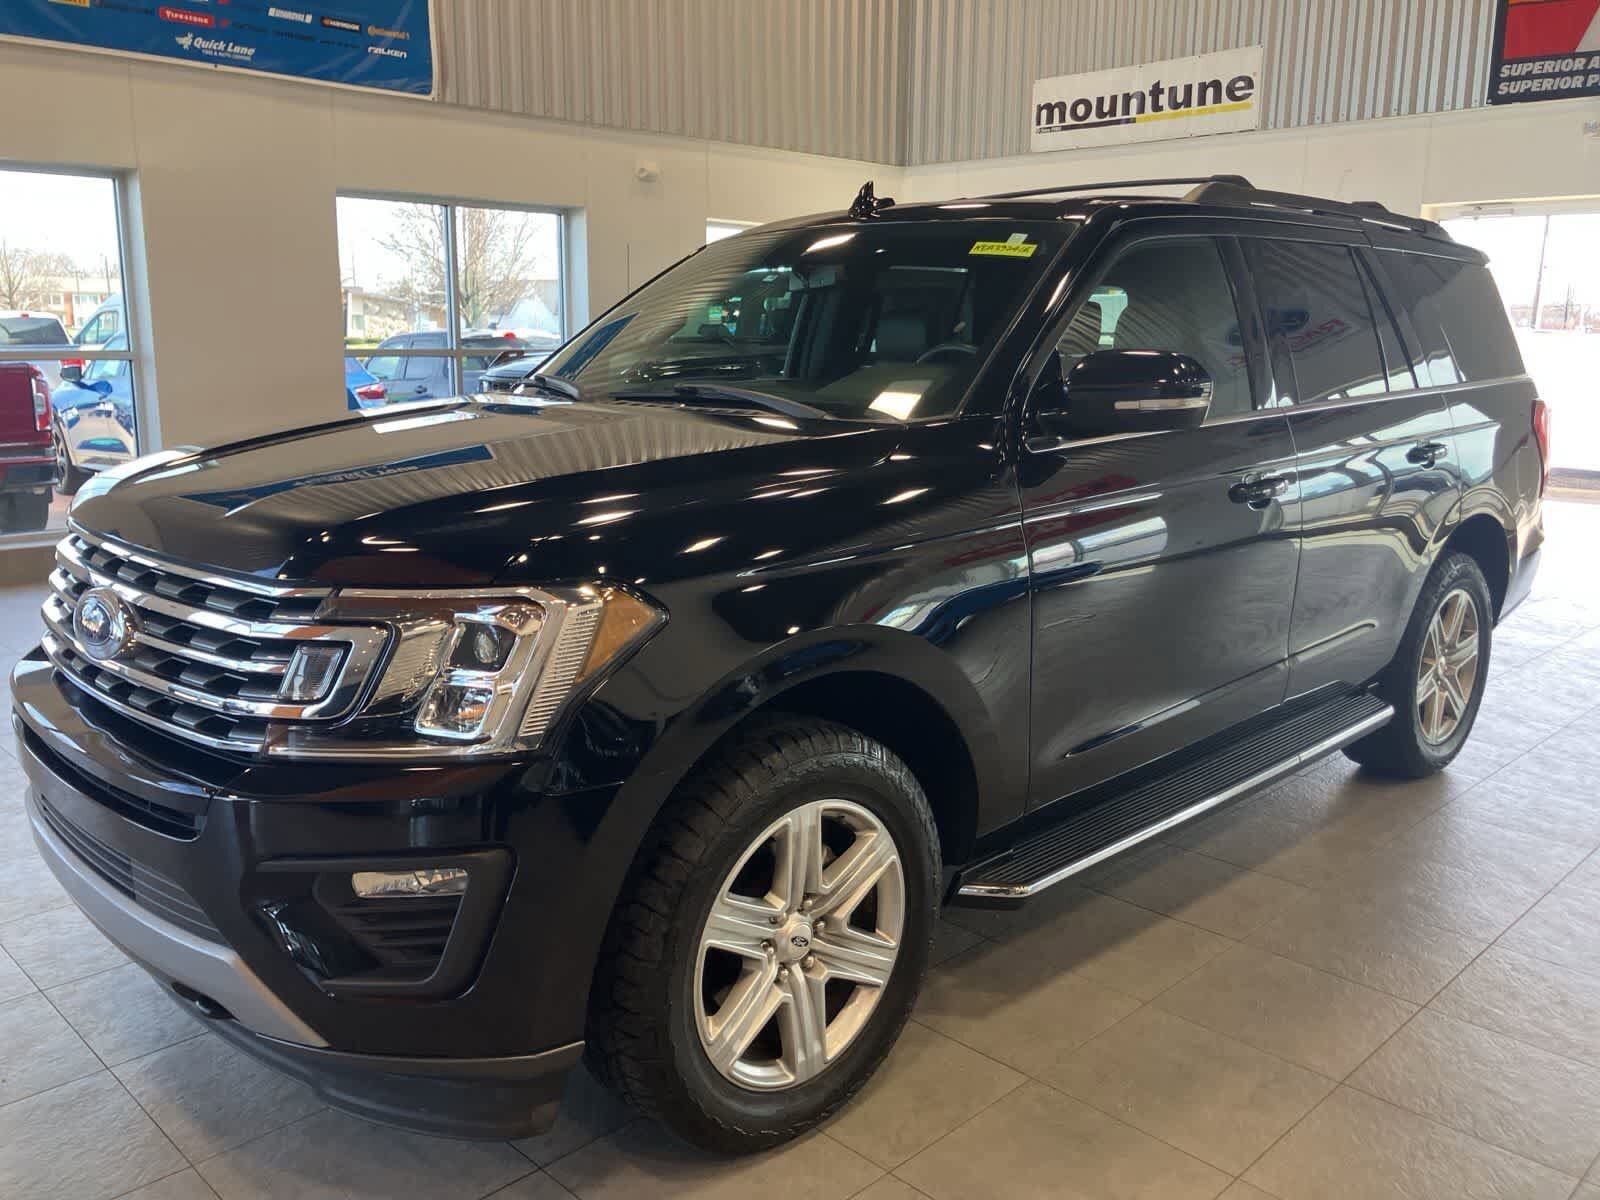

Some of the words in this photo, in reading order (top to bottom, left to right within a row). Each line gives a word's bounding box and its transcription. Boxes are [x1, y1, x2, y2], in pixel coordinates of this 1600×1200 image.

[193, 37, 226, 51] Quick
[226, 42, 257, 56] Lane
[1499, 57, 1586, 78] SUPERIOR
[1497, 75, 1584, 95] SUPERIOR
[1035, 74, 1255, 126] mountune
